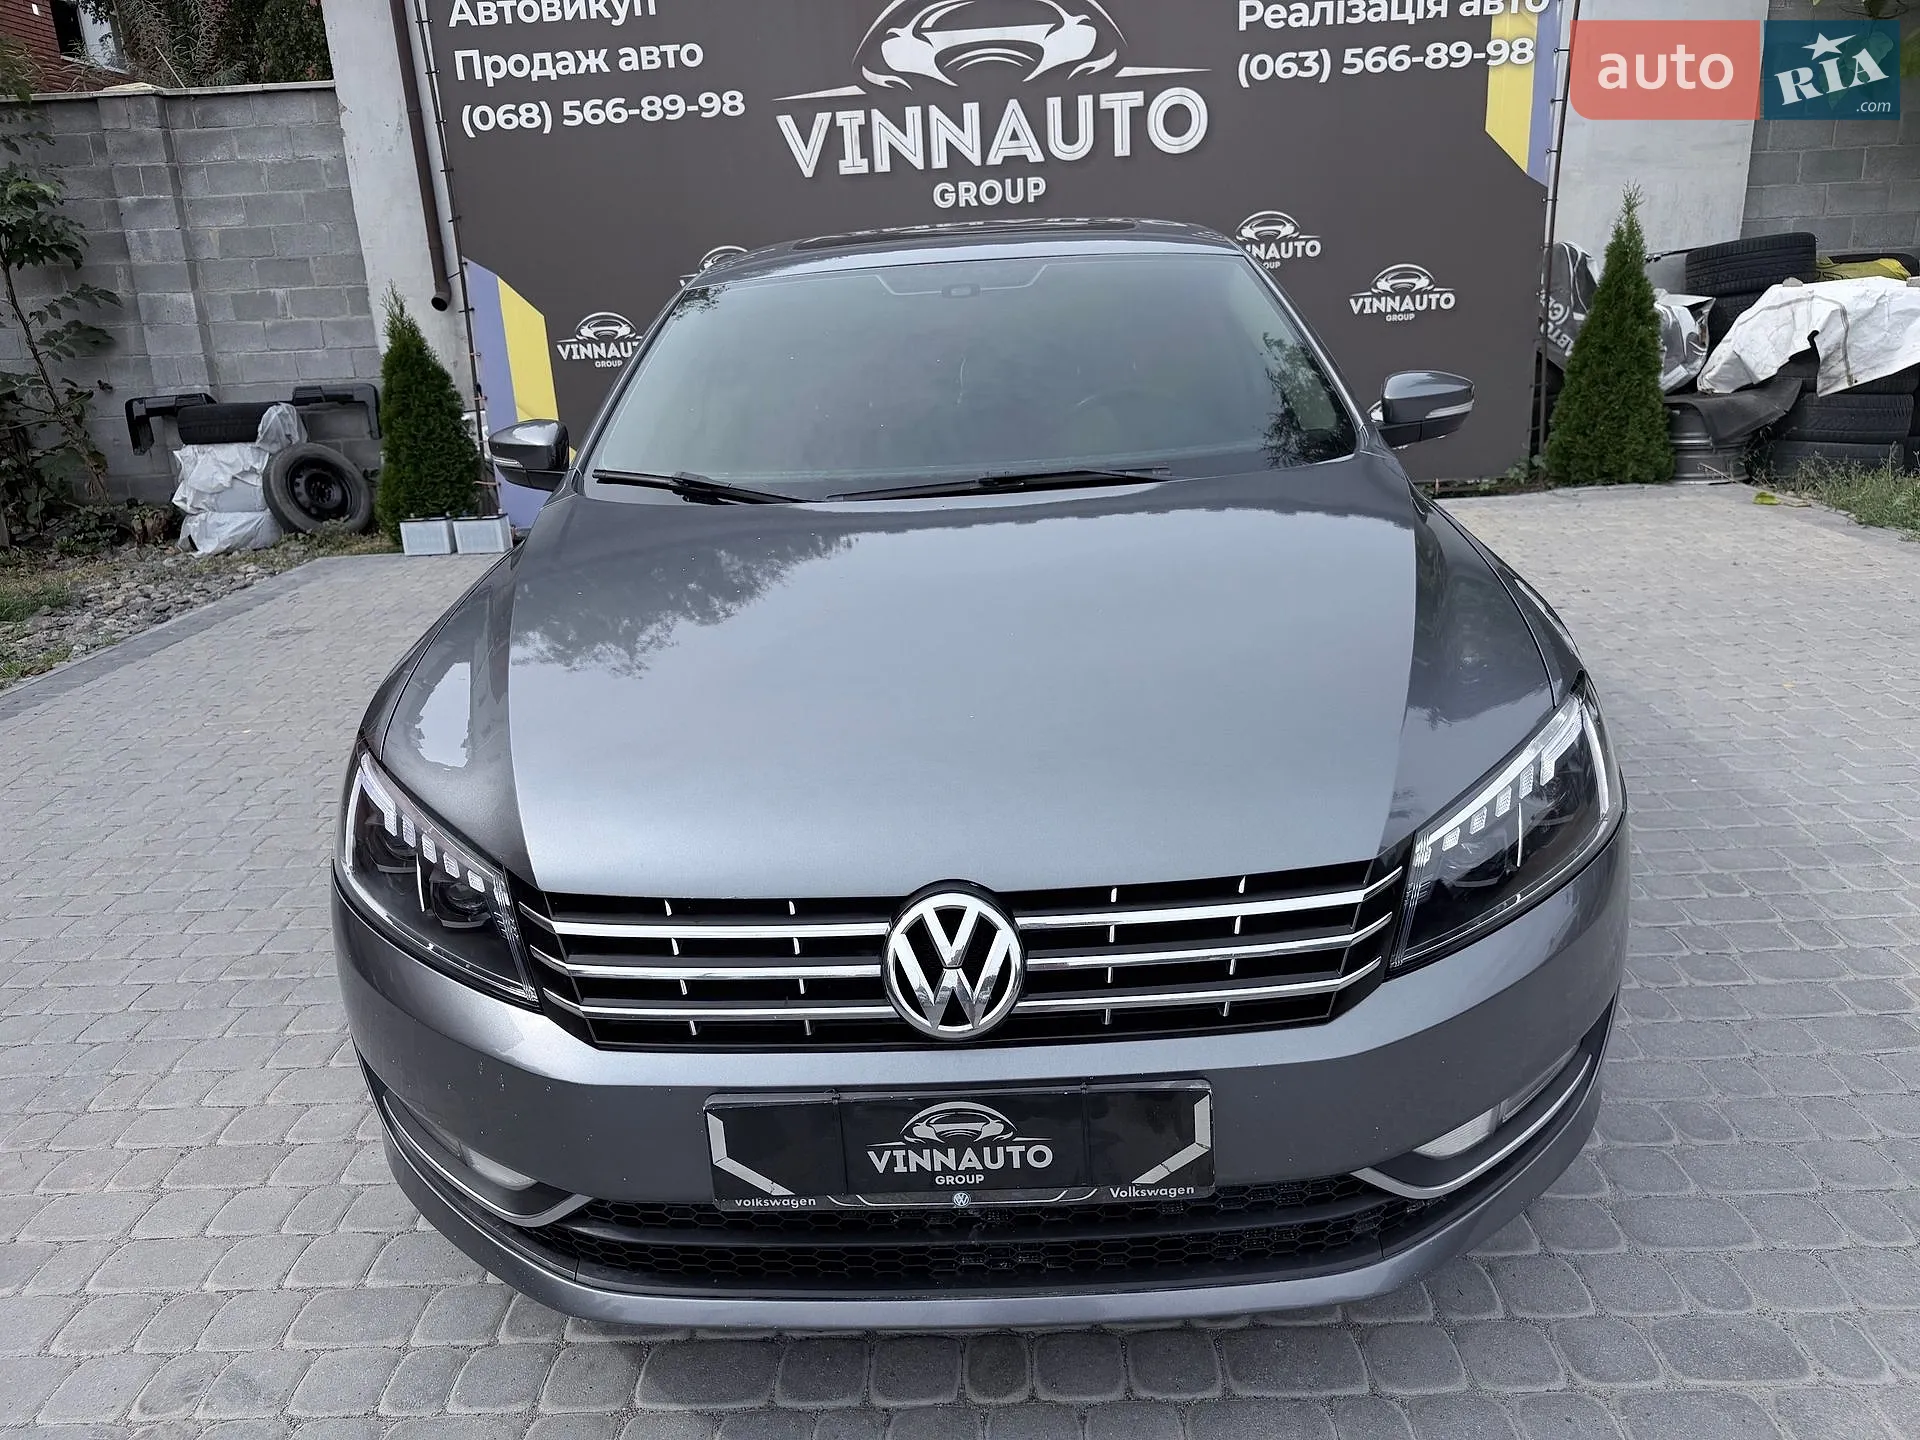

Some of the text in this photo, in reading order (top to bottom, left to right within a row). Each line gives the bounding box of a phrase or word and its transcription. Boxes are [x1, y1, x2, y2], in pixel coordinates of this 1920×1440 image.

[449, 0, 656, 27] Автовикуп
[1238, 0, 1549, 31] Реалізація авто
[454, 43, 704, 87] Продаж авто
[1238, 37, 1535, 88] (063) 566-89-98
[462, 90, 746, 138] (068) 566-89-98
[775, 87, 1209, 178] VINNAUTO
[933, 176, 1046, 209] GROUP
[1245, 240, 1321, 260] NAUTO
[1350, 293, 1455, 315] VINNAUTO
[1386, 313, 1415, 322] GROUP
[556, 341, 639, 361] VINNAU
[595, 360, 623, 368] GROUP
[867, 1144, 1054, 1174] VINNAUTO
[935, 1173, 985, 1186] GROUP
[1109, 1186, 1195, 1198] Volkswagen
